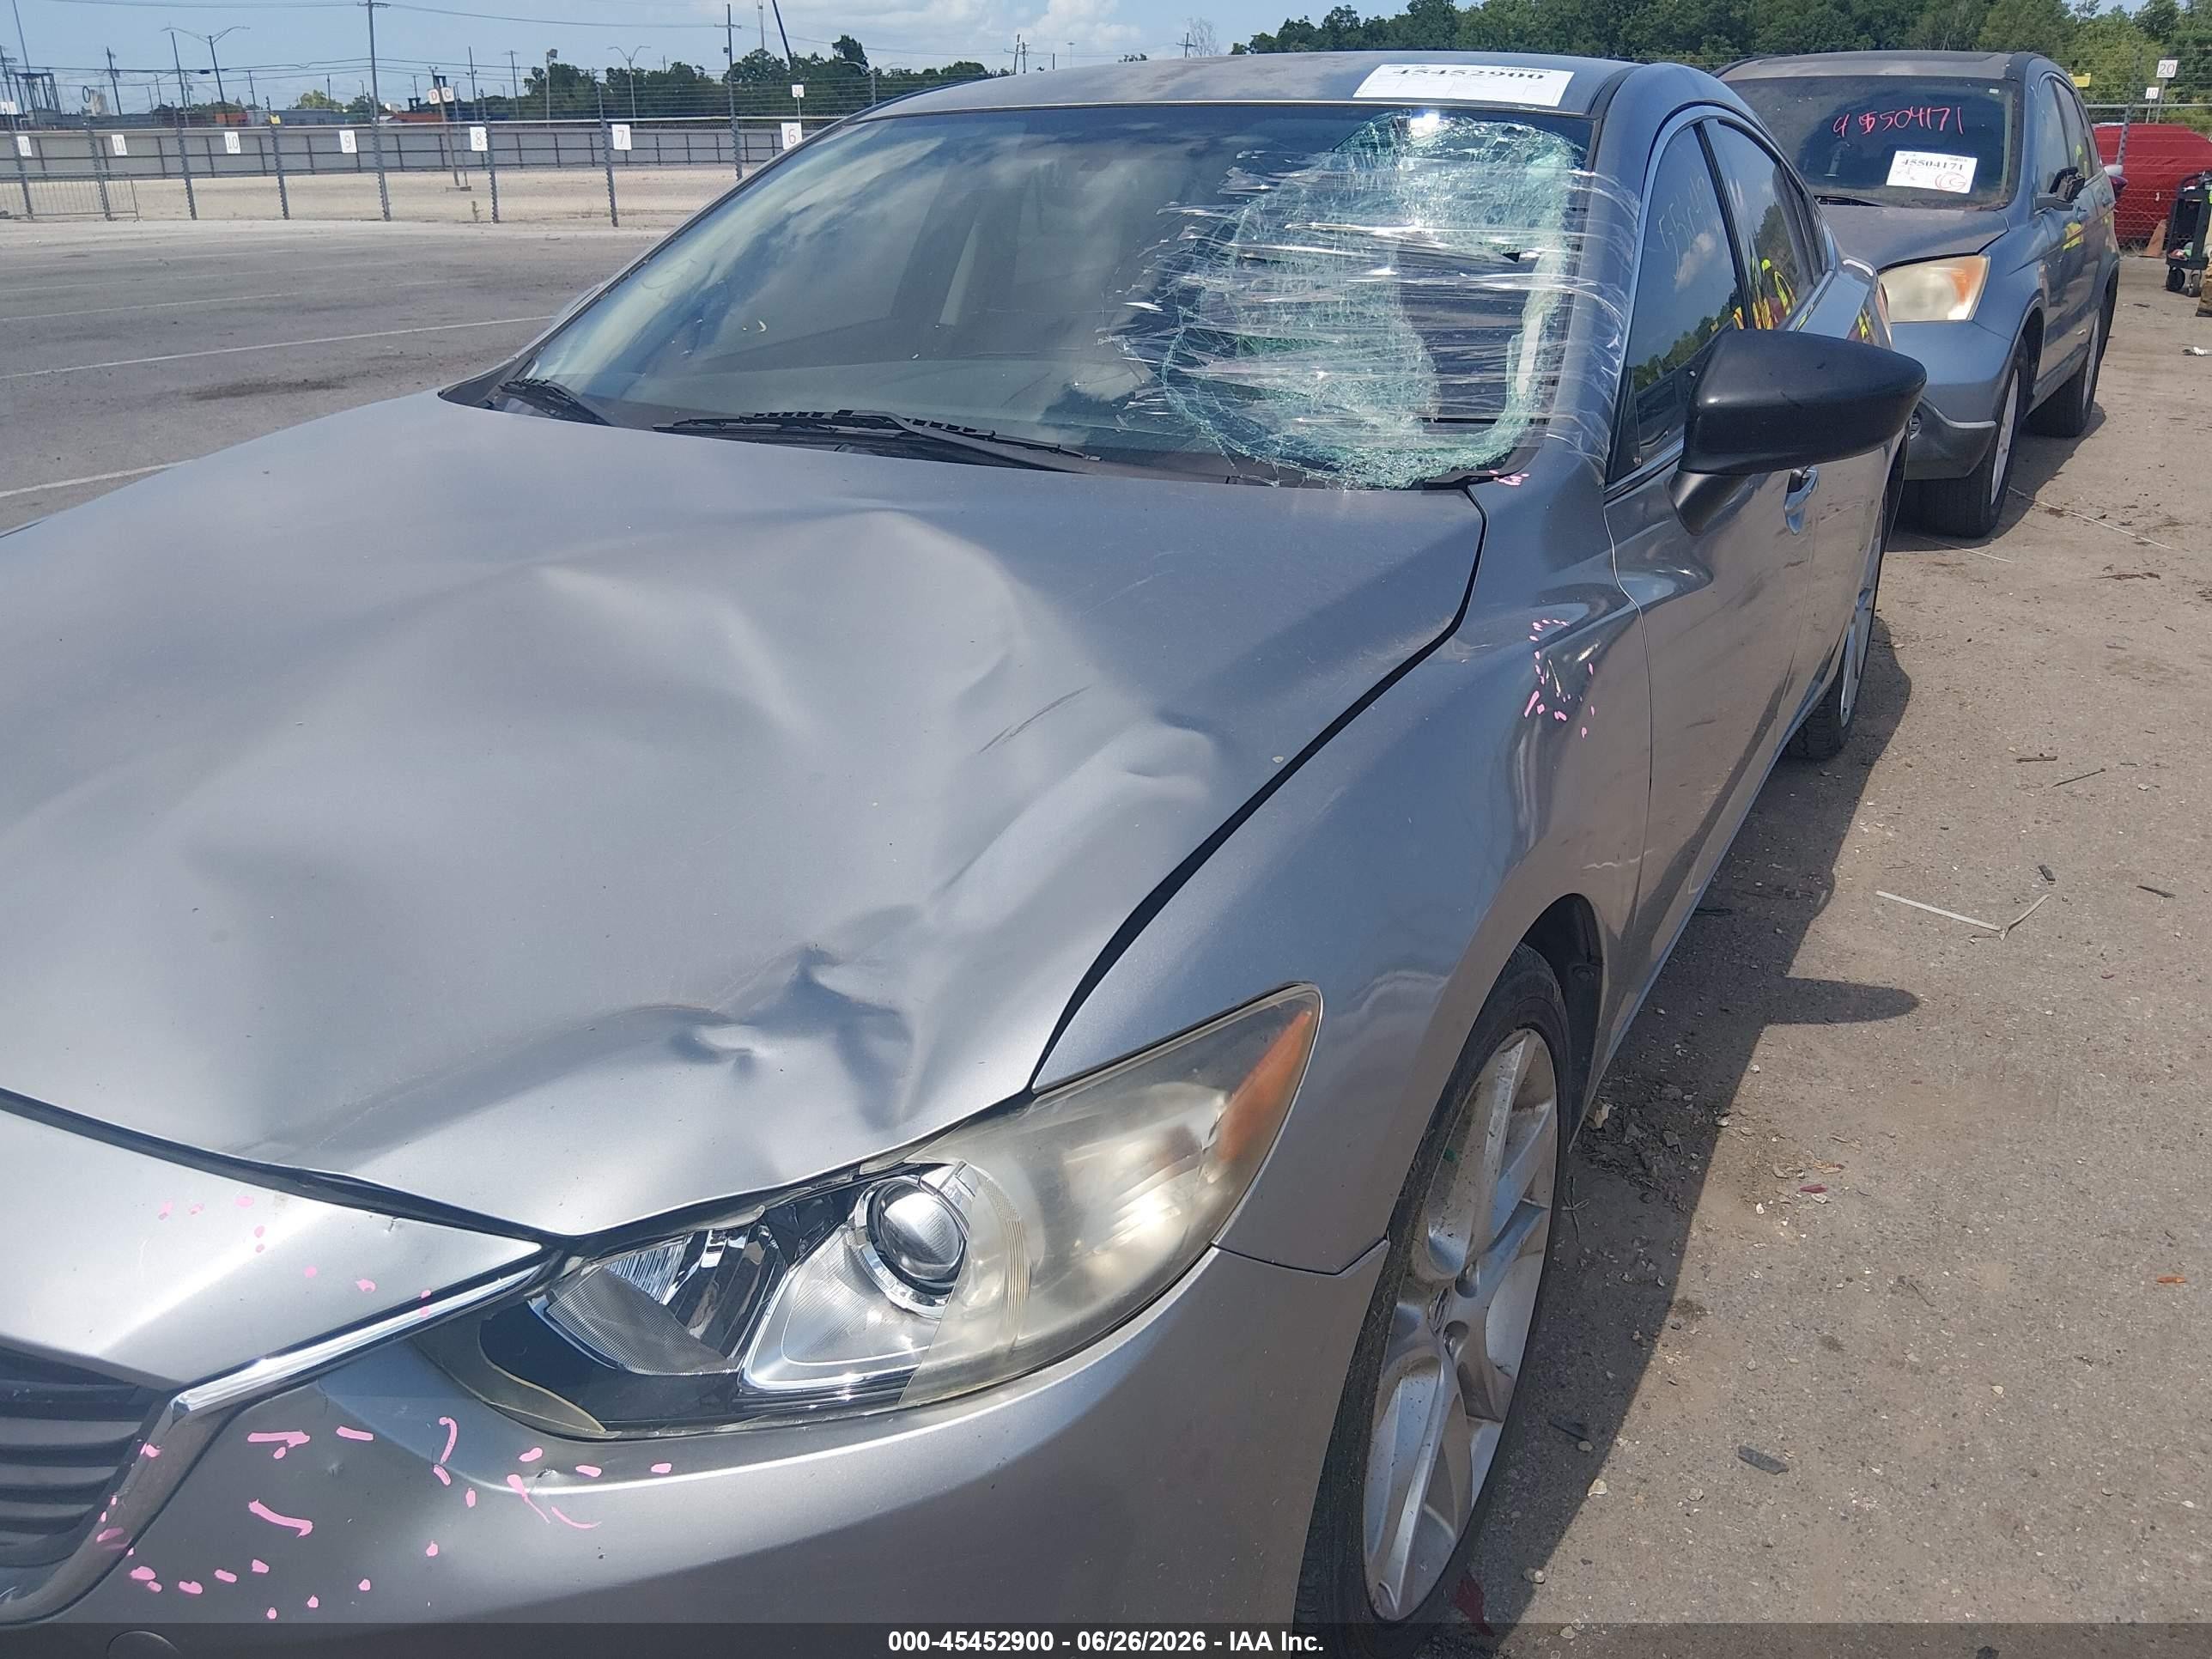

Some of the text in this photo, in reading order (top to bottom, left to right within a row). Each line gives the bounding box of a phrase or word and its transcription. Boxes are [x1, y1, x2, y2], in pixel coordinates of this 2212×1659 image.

[1392, 69, 1544, 80] 45452900
[2158, 63, 2175, 75] 20
[227, 136, 239, 149] 10
[343, 136, 352, 149] 9
[475, 132, 483, 146] 8
[617, 130, 625, 144] 7
[788, 128, 796, 144] 6
[1901, 159, 1963, 170] 45504171
